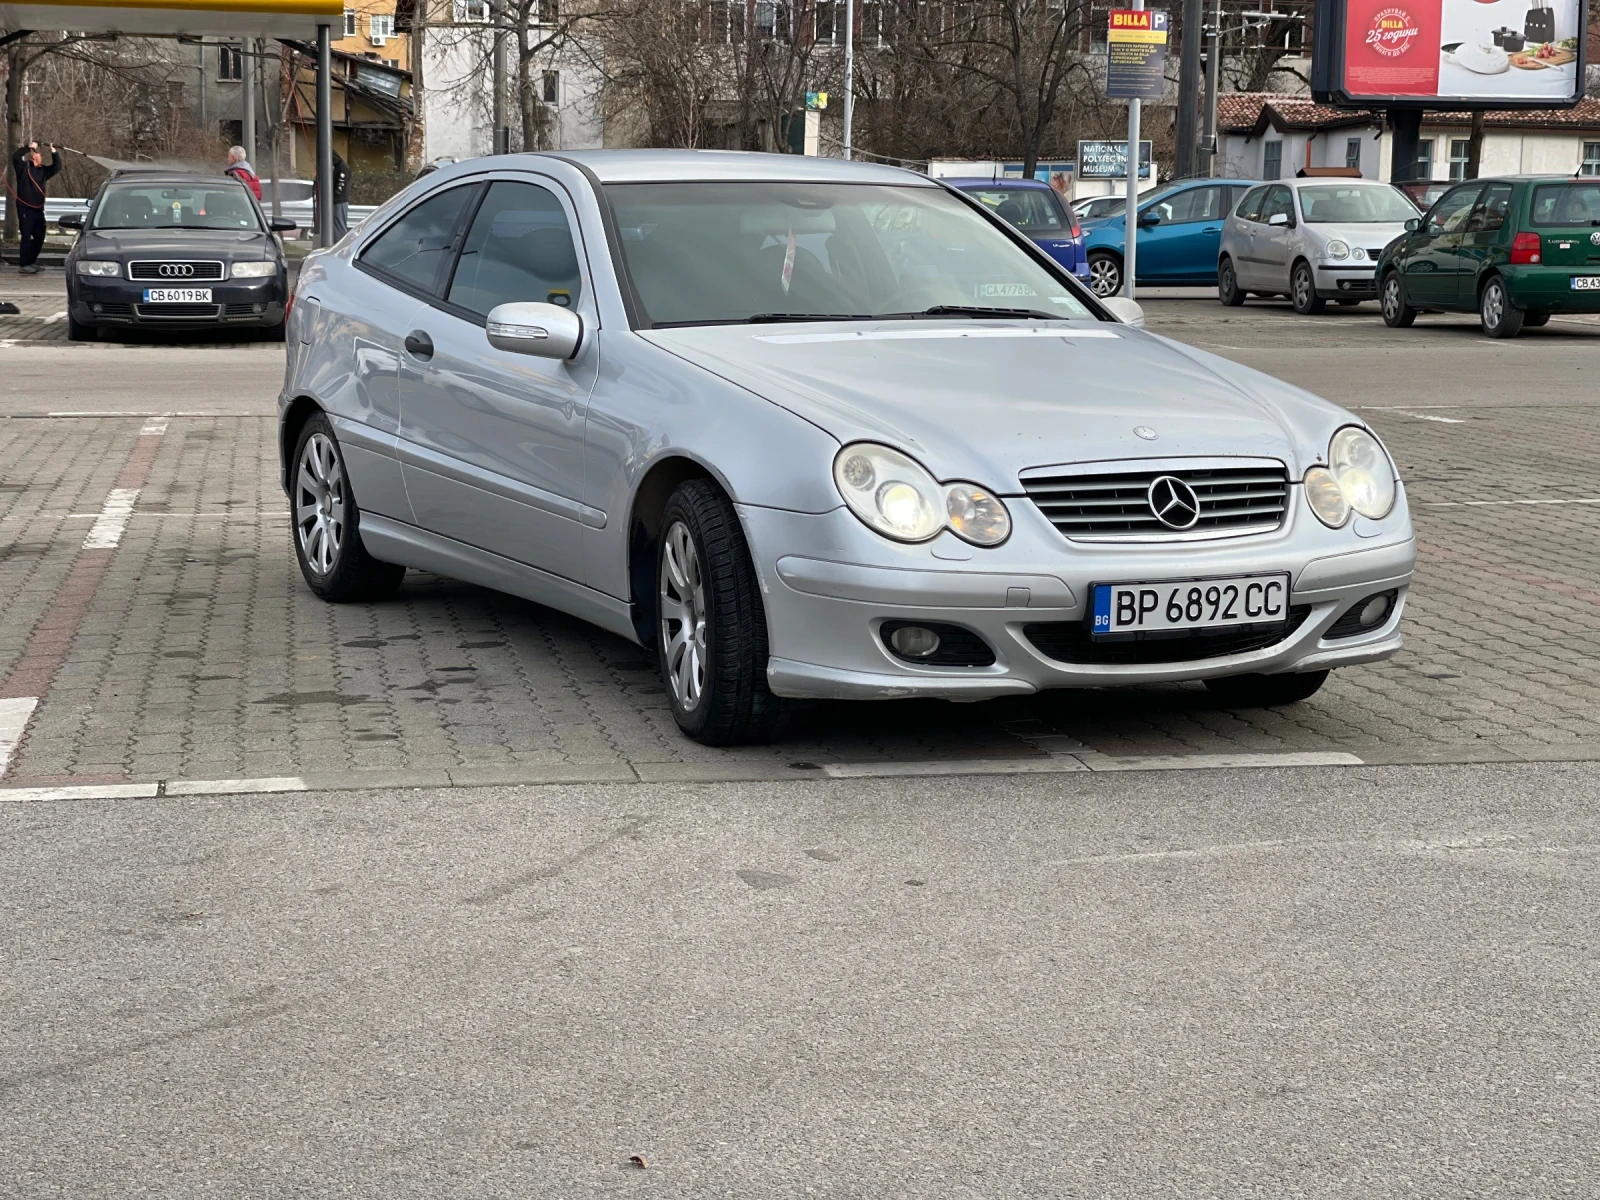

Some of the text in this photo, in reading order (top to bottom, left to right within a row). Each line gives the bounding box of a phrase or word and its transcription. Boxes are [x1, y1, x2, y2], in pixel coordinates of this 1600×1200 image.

[1114, 14, 1148, 26] BILLA
[1154, 14, 1165, 29] P
[1381, 20, 1404, 29] BILLA
[1366, 28, 1419, 43] 25 години
[1083, 145, 1122, 153] NATIONAL
[1082, 165, 1115, 173] MUSEUM
[1576, 278, 1588, 288] CB
[151, 290, 209, 301] CB 6019 BK
[987, 285, 999, 295] CA
[1116, 581, 1282, 626] BP 6892 CC
[1095, 615, 1109, 626] BG
